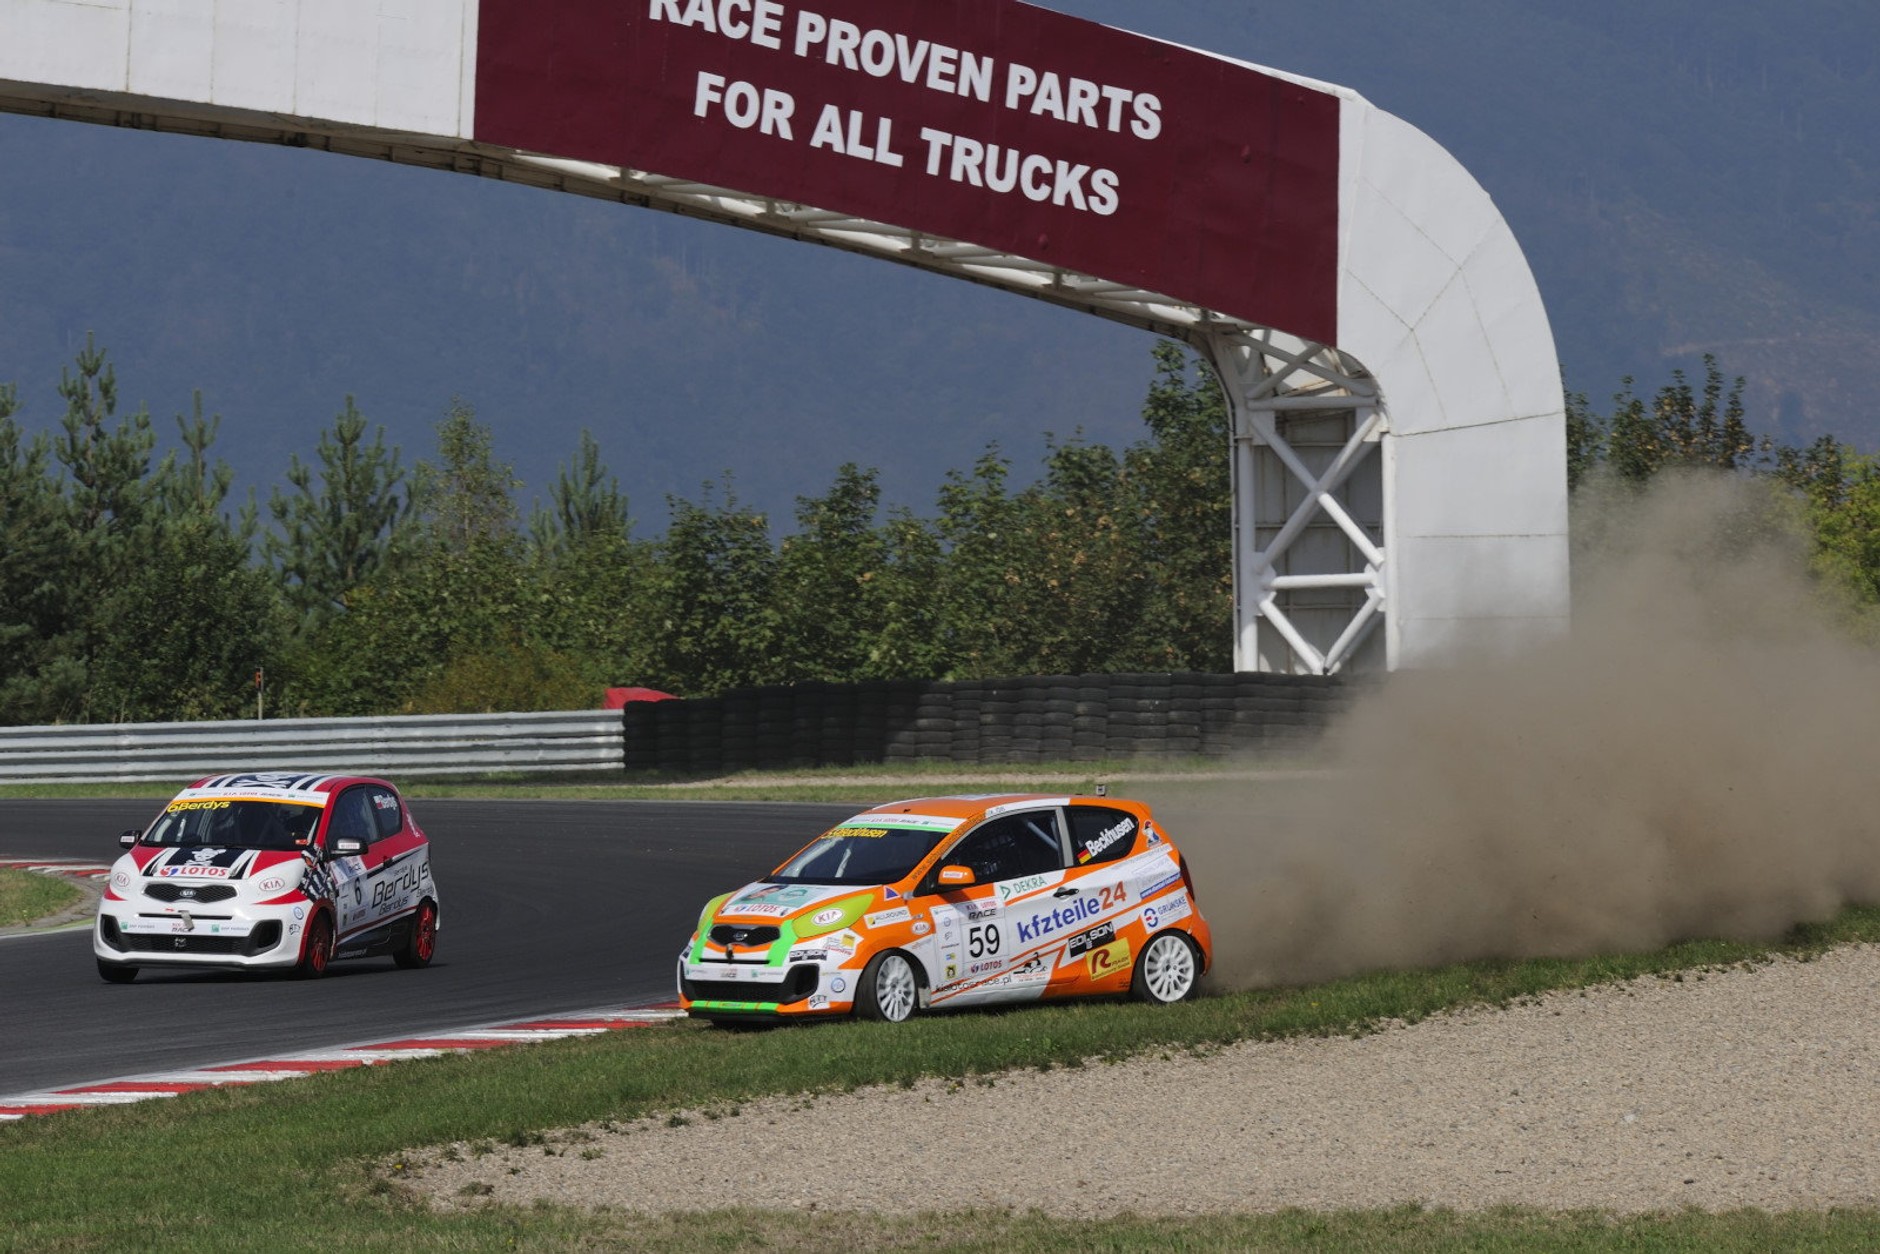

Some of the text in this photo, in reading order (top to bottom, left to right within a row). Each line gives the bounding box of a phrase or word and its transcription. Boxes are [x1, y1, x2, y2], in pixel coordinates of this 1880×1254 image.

[795, 10, 994, 102] PROVEN
[1006, 63, 1163, 141] PARTS
[694, 71, 1120, 216] FOR ALL TRUCKS
[1085, 817, 1135, 857] Beckhusen
[181, 866, 228, 876] LOTOS
[263, 881, 282, 890] KIA
[354, 877, 362, 905] 6
[372, 861, 429, 909] Berdys
[1013, 876, 1047, 894] DEKRA
[745, 904, 779, 913] LOTOS
[818, 911, 838, 923] KIA
[968, 908, 997, 920] RACE
[1017, 881, 1128, 943] kfzteile24
[969, 924, 1001, 958] 59
[981, 960, 1003, 971] LOTOS
